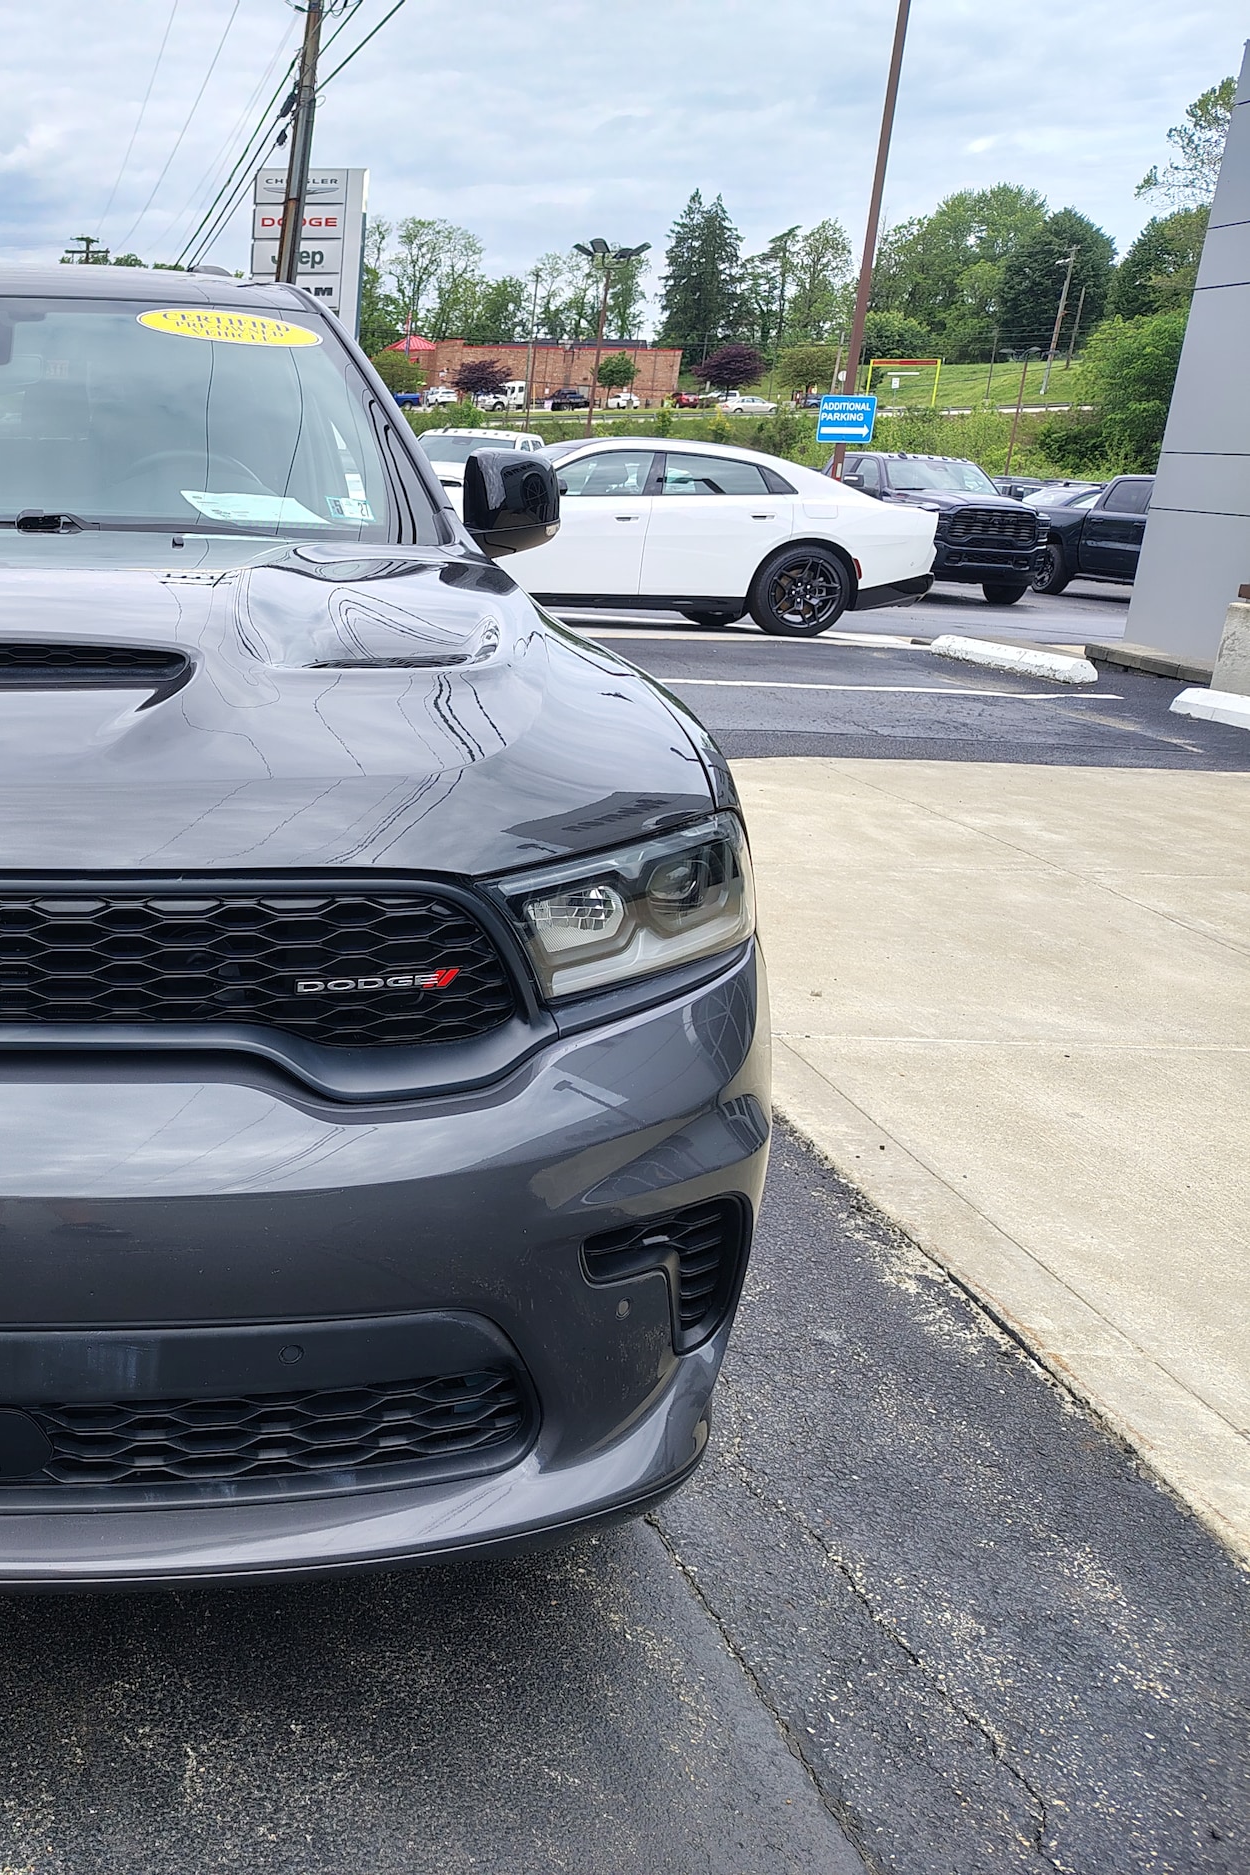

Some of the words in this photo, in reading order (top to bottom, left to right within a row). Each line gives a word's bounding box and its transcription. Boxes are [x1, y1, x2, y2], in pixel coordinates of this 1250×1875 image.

[162, 312, 290, 332] CERTIFIED
[192, 328, 274, 342] VEHICLE
[822, 402, 871, 411] ADDITIONAL
[821, 413, 864, 421] PARKING
[297, 974, 440, 993] DODGE
